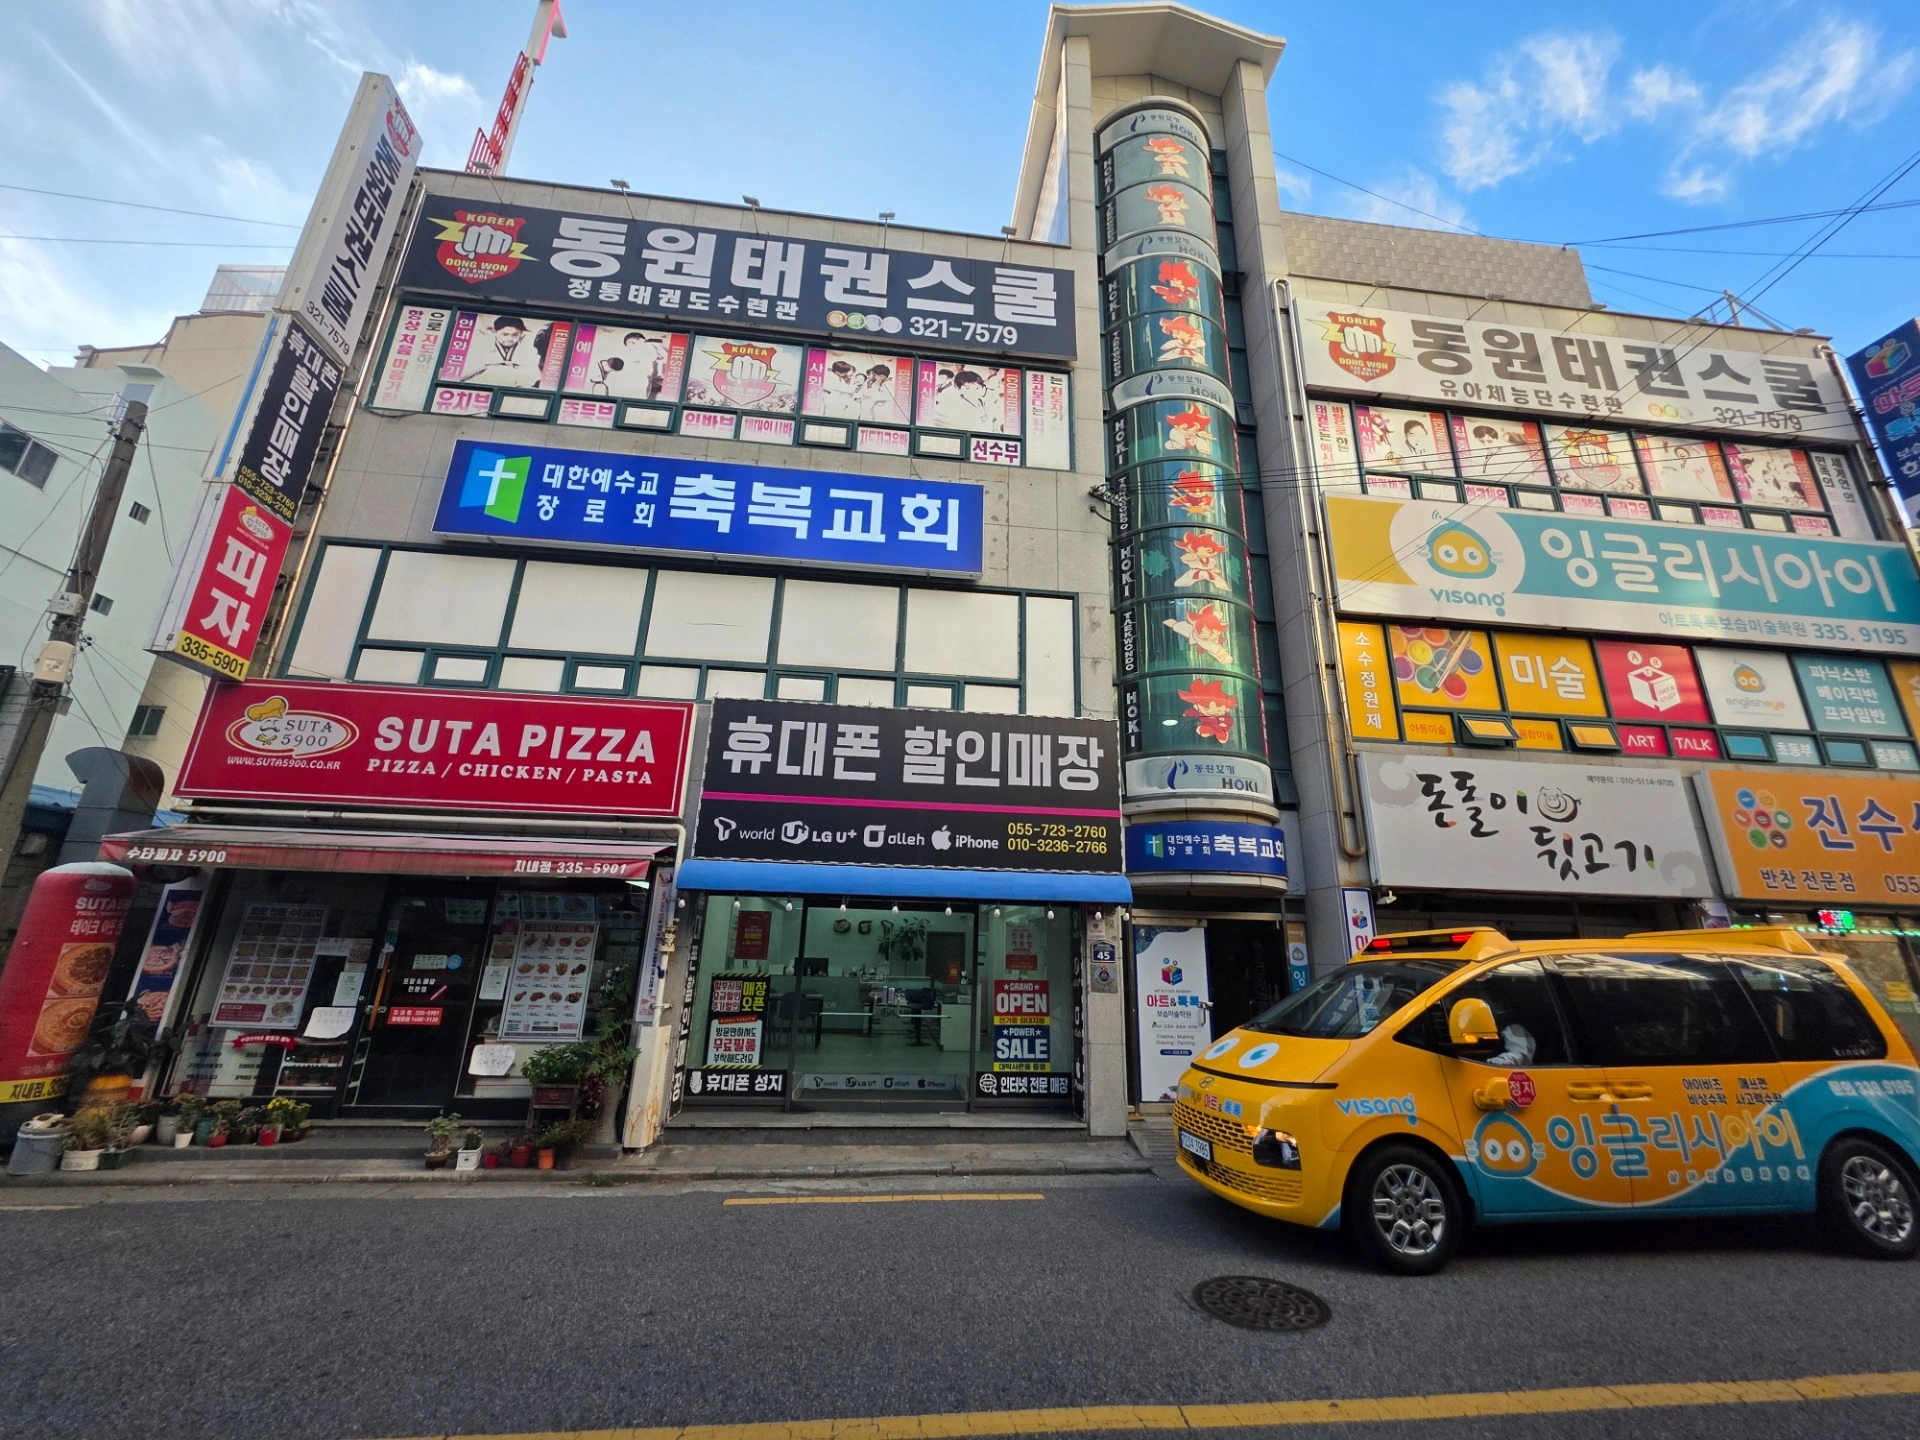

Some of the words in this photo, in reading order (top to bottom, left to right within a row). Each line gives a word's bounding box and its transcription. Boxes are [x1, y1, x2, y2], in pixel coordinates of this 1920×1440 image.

[1169, 123, 1198, 143] HOKI
[1103, 158, 1113, 194] HOKI
[466, 212, 516, 228] KOREA
[321, 133, 402, 331] 동원태권스쿨
[1178, 245, 1210, 263] HOKI
[445, 258, 478, 269] DONG
[480, 261, 509, 273] WON
[550, 217, 1057, 327] 동원태권스쿨
[1108, 281, 1121, 321] HOKI
[306, 301, 350, 355] 321-7579
[404, 309, 424, 331] 항상
[1338, 315, 1377, 328] KOREA
[909, 316, 1018, 345] 321-7579
[396, 333, 417, 356] 처음
[731, 346, 768, 357] KOREA
[288, 329, 339, 391] 휴대폰
[571, 340, 592, 381] 예의
[1339, 357, 1364, 367] DONG
[1366, 361, 1389, 370] WON
[1410, 318, 1828, 415] 동원태권스쿨
[436, 388, 491, 411] 유치부
[1190, 386, 1222, 405] HOKI
[260, 364, 319, 487] 할인매장
[1713, 406, 1802, 431] 321-7579
[972, 439, 1019, 463] 선수부
[1114, 419, 1129, 465] HOKI
[241, 465, 296, 510] 055-723-2760
[541, 463, 659, 496] 대한예수교
[669, 474, 960, 552] 축복교회
[1120, 546, 1135, 597] HOKI
[1540, 527, 1896, 613] 잉글리시아이
[200, 535, 268, 649] 피자
[1123, 612, 1136, 671] TAEKWONDO
[1859, 628, 1908, 645] 9195
[181, 637, 245, 677] 335-5901
[1355, 631, 1382, 730] 소수정원제
[1509, 653, 1586, 700] 미술
[1809, 664, 1872, 684] 파닉스반
[1816, 685, 1879, 704] 베이직반
[1126, 692, 1141, 748] HOKI
[1825, 706, 1886, 724] 프라임반
[284, 719, 333, 735] SUTA
[1409, 724, 1447, 736] 아동미술
[280, 733, 328, 747] 5900
[374, 716, 501, 756] SUTA
[518, 724, 656, 764] PIZZA
[1627, 734, 1655, 748] ART
[1675, 737, 1712, 751] TALK
[1776, 742, 1813, 758] 초등부
[227, 756, 341, 769] WWW.SUTA5900.CO.KR
[722, 715, 880, 782] 휴대폰
[902, 725, 1104, 792] 할인매장
[366, 758, 437, 776] PIZZA
[458, 763, 563, 781] CHICKEN
[582, 768, 653, 785] PASTA
[1222, 778, 1258, 793] HOKI
[1416, 770, 1528, 838] 돈돌이
[739, 827, 775, 841] world
[1007, 821, 1107, 840] 055-723-2760
[1802, 796, 1920, 853] 진수
[812, 830, 832, 843] LG
[835, 828, 858, 843] U+
[887, 826, 925, 846] olleh
[955, 834, 999, 850] iPhone
[127, 847, 183, 861] 수타피자
[188, 850, 226, 863] 5900
[1007, 837, 1108, 855] 010-3236-2766
[1167, 834, 1210, 845] 대한예수교
[1213, 834, 1285, 861] 축복교회
[1529, 826, 1656, 881] 뒷고기
[557, 862, 628, 875] 335-5901
[1760, 869, 1800, 890] 반찬
[1801, 871, 1857, 892] 전문점
[1096, 951, 1111, 960] 45
[743, 981, 767, 997] 매장
[1010, 983, 1033, 991] GRAND
[742, 997, 765, 1012] 오픈
[996, 993, 1047, 1014] OPEN
[715, 1027, 757, 1037] 방문만하셔도
[1009, 1027, 1035, 1037] POWER
[713, 1038, 756, 1052] 무료필름
[996, 1038, 1048, 1060] SALE
[713, 1053, 754, 1064] 부착해드려요
[706, 1074, 750, 1092] 휴대폰
[754, 1074, 783, 1092] 성지
[1000, 1077, 1028, 1094] 인터넷
[1029, 1077, 1048, 1094] 전문
[1050, 1077, 1069, 1094] 매장
[1509, 1081, 1535, 1096] 정지
[1688, 1093, 1728, 1106] 비상수학
[1736, 1093, 1785, 1106] 사고력수학
[1335, 1094, 1418, 1126] visang
[1546, 1109, 1806, 1179] 잉글리시아이
